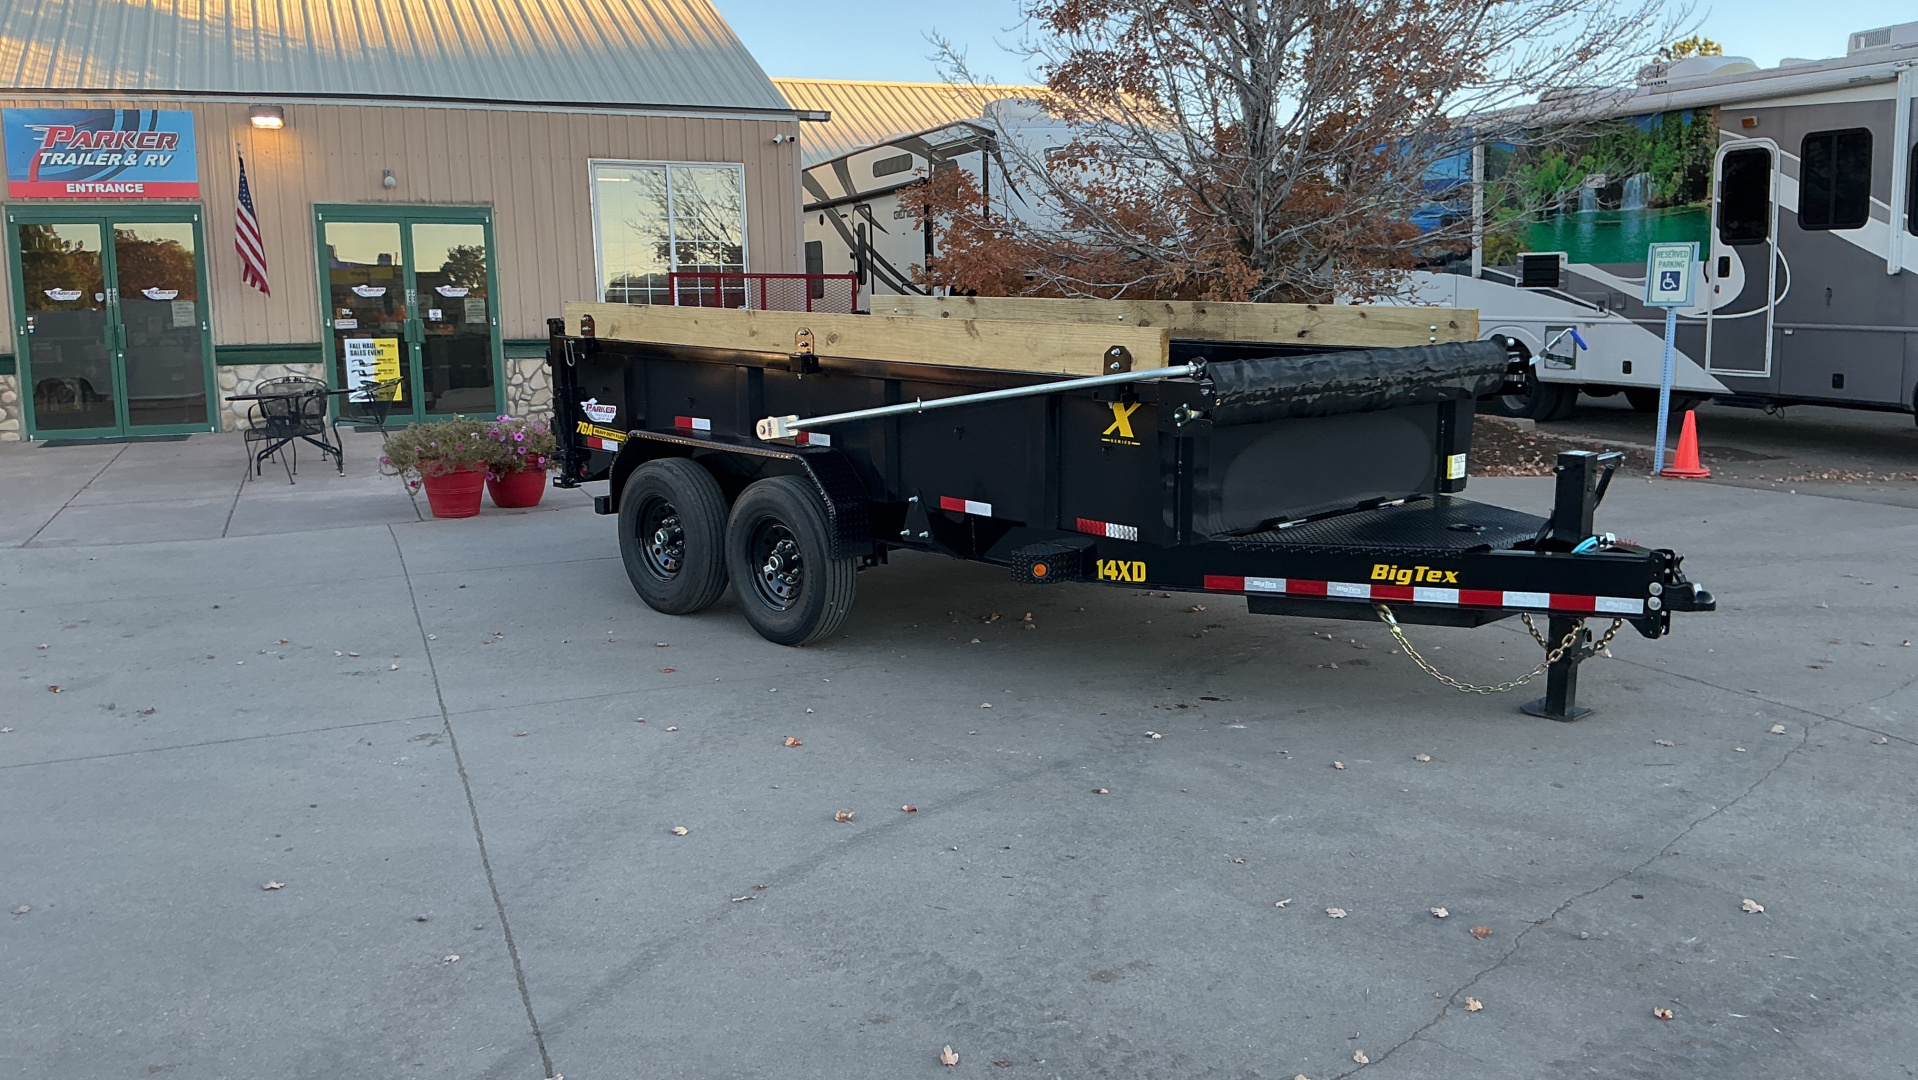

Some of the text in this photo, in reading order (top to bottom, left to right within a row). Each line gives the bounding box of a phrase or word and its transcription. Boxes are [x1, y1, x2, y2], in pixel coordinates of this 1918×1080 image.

[42, 125, 179, 151] PARKER
[40, 152, 172, 167] TRAILER & RV
[66, 183, 144, 193] ENTRANCE
[1657, 250, 1688, 259] RESERVED
[1658, 260, 1685, 269] PARKING
[586, 404, 615, 414] PARKER
[1102, 402, 1141, 438] X
[576, 421, 594, 436] 7GA
[1097, 559, 1146, 582] 14XD
[1370, 564, 1459, 585] BigTex
[1253, 580, 1277, 588] BigTex
